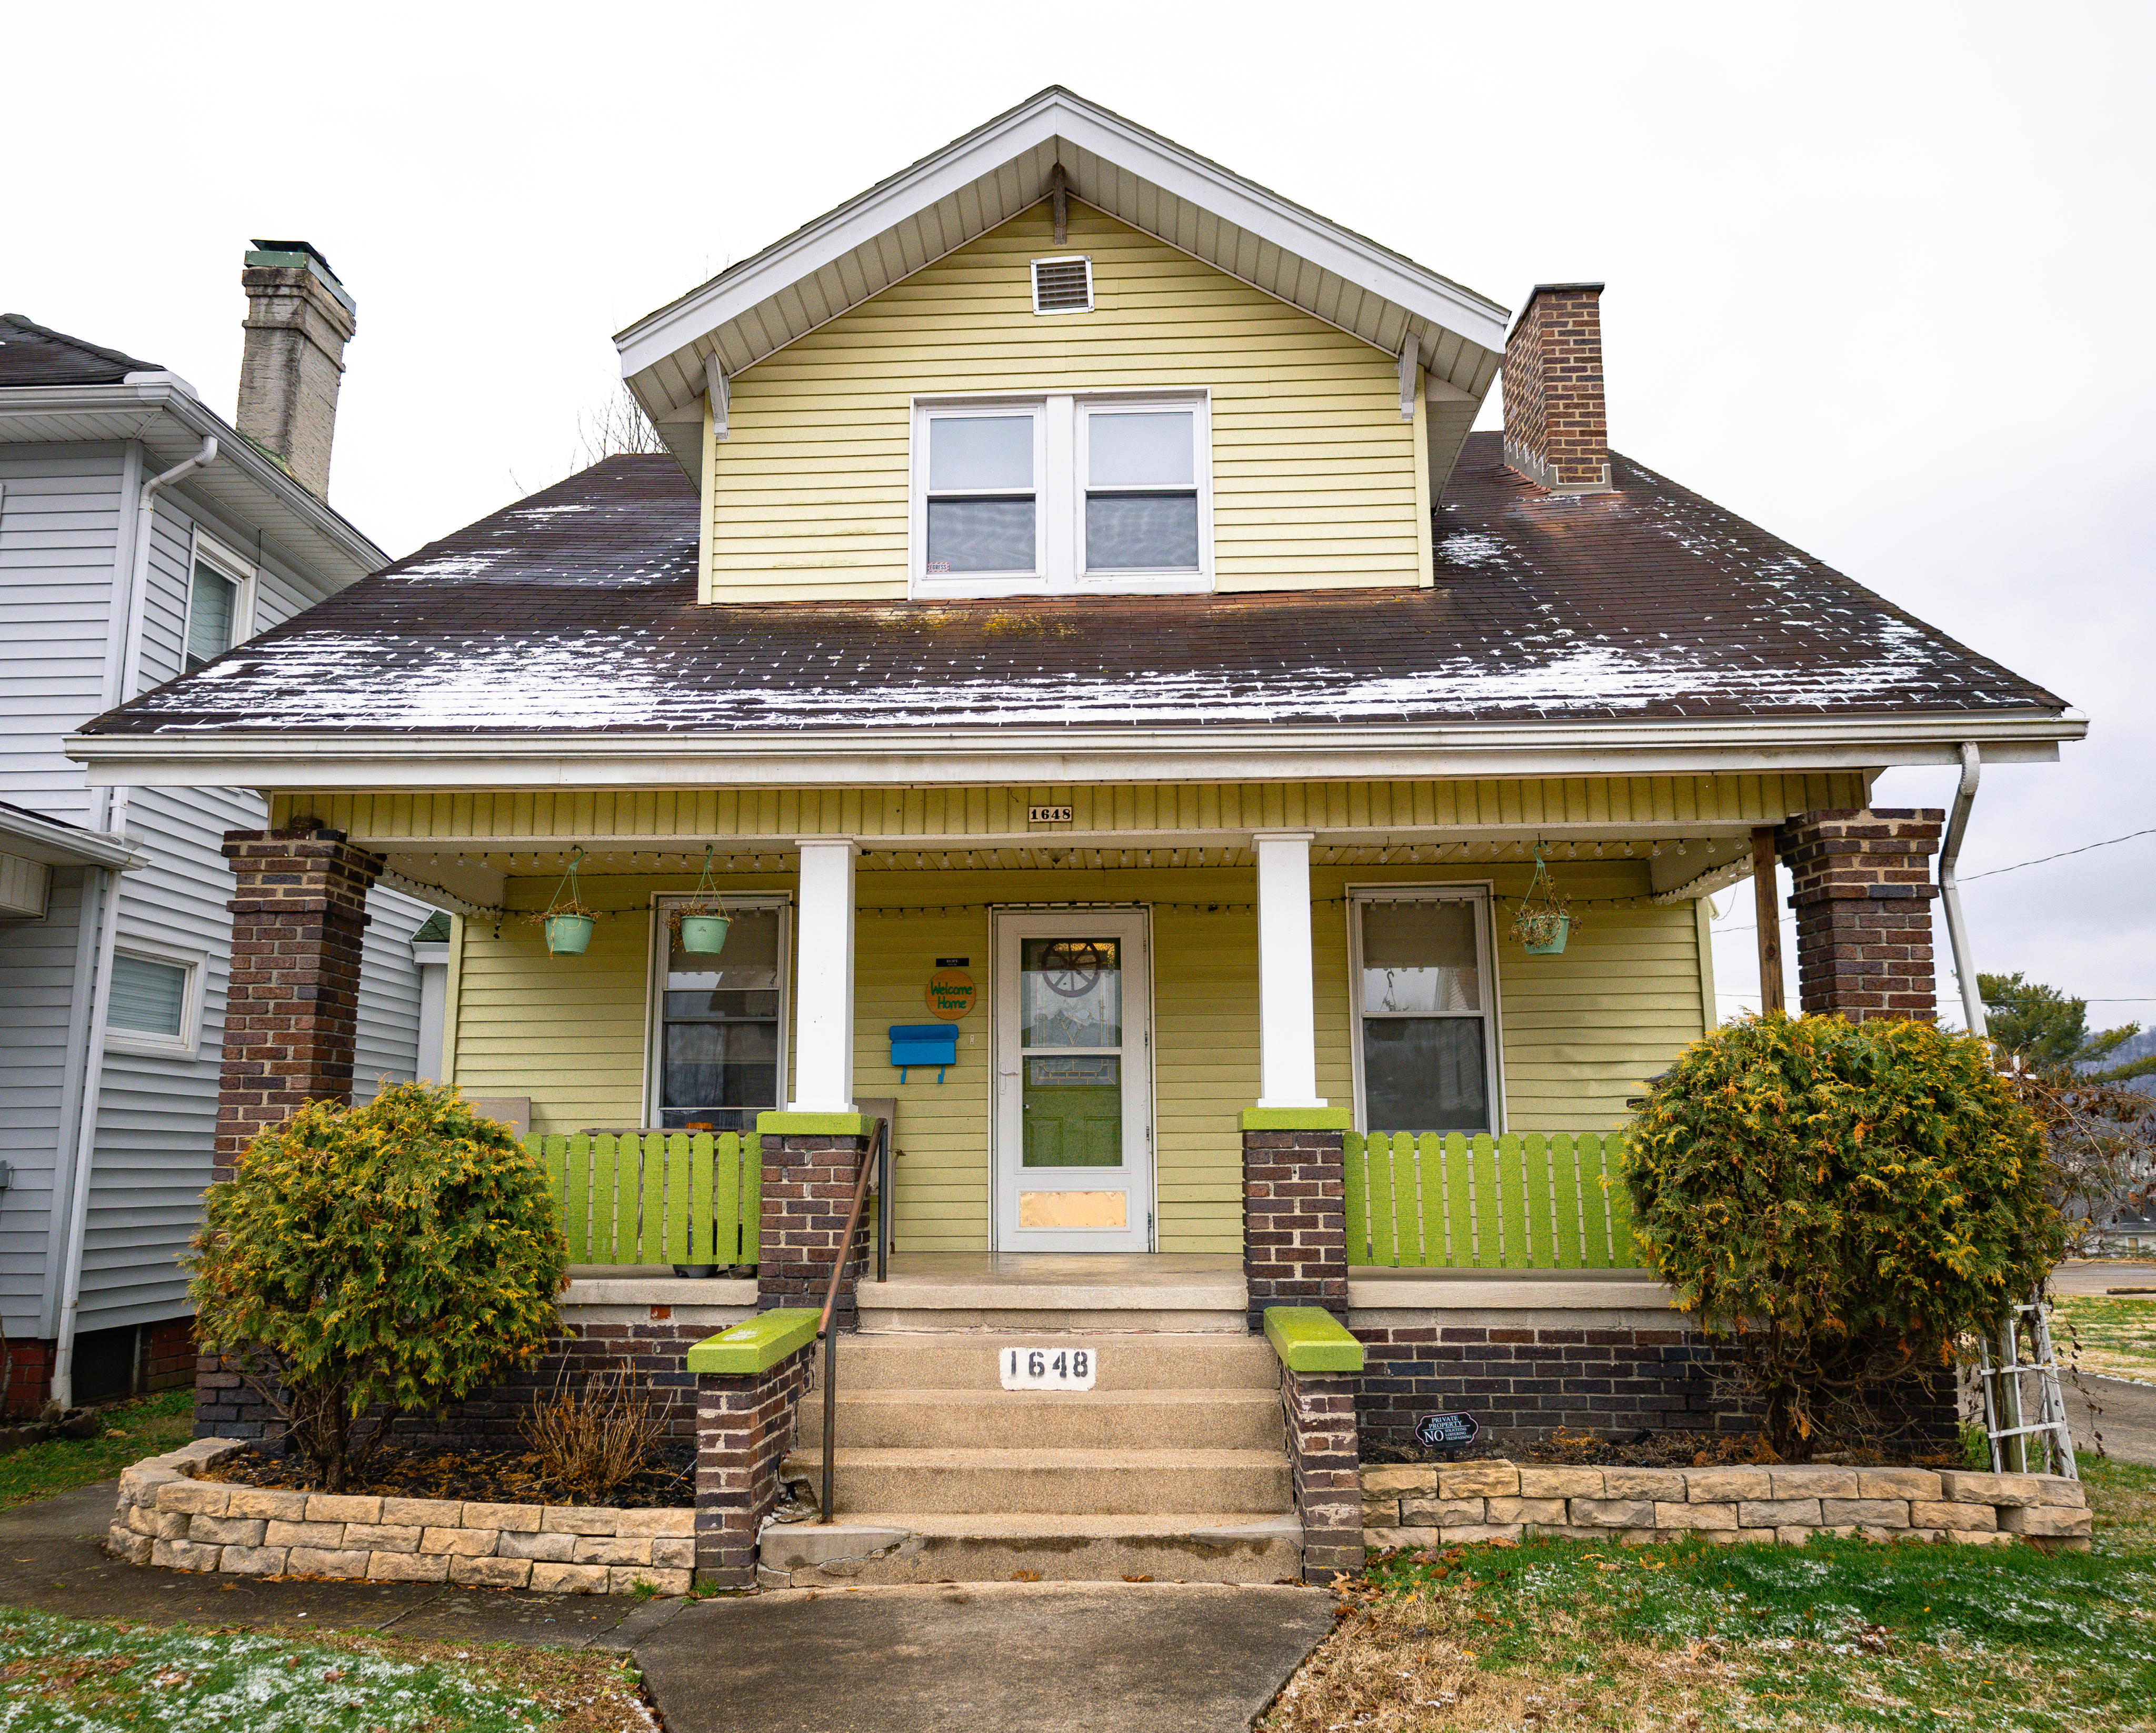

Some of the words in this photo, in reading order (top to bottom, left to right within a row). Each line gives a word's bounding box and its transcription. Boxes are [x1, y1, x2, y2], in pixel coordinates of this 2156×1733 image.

[1030, 809, 1071, 820] 1648
[931, 981, 973, 995] Welcome
[937, 995, 966, 1009] Home
[1011, 1351, 1088, 1378] 1648
[1429, 1420, 1462, 1429] PROPERTY
[1424, 1430, 1444, 1442] NO
